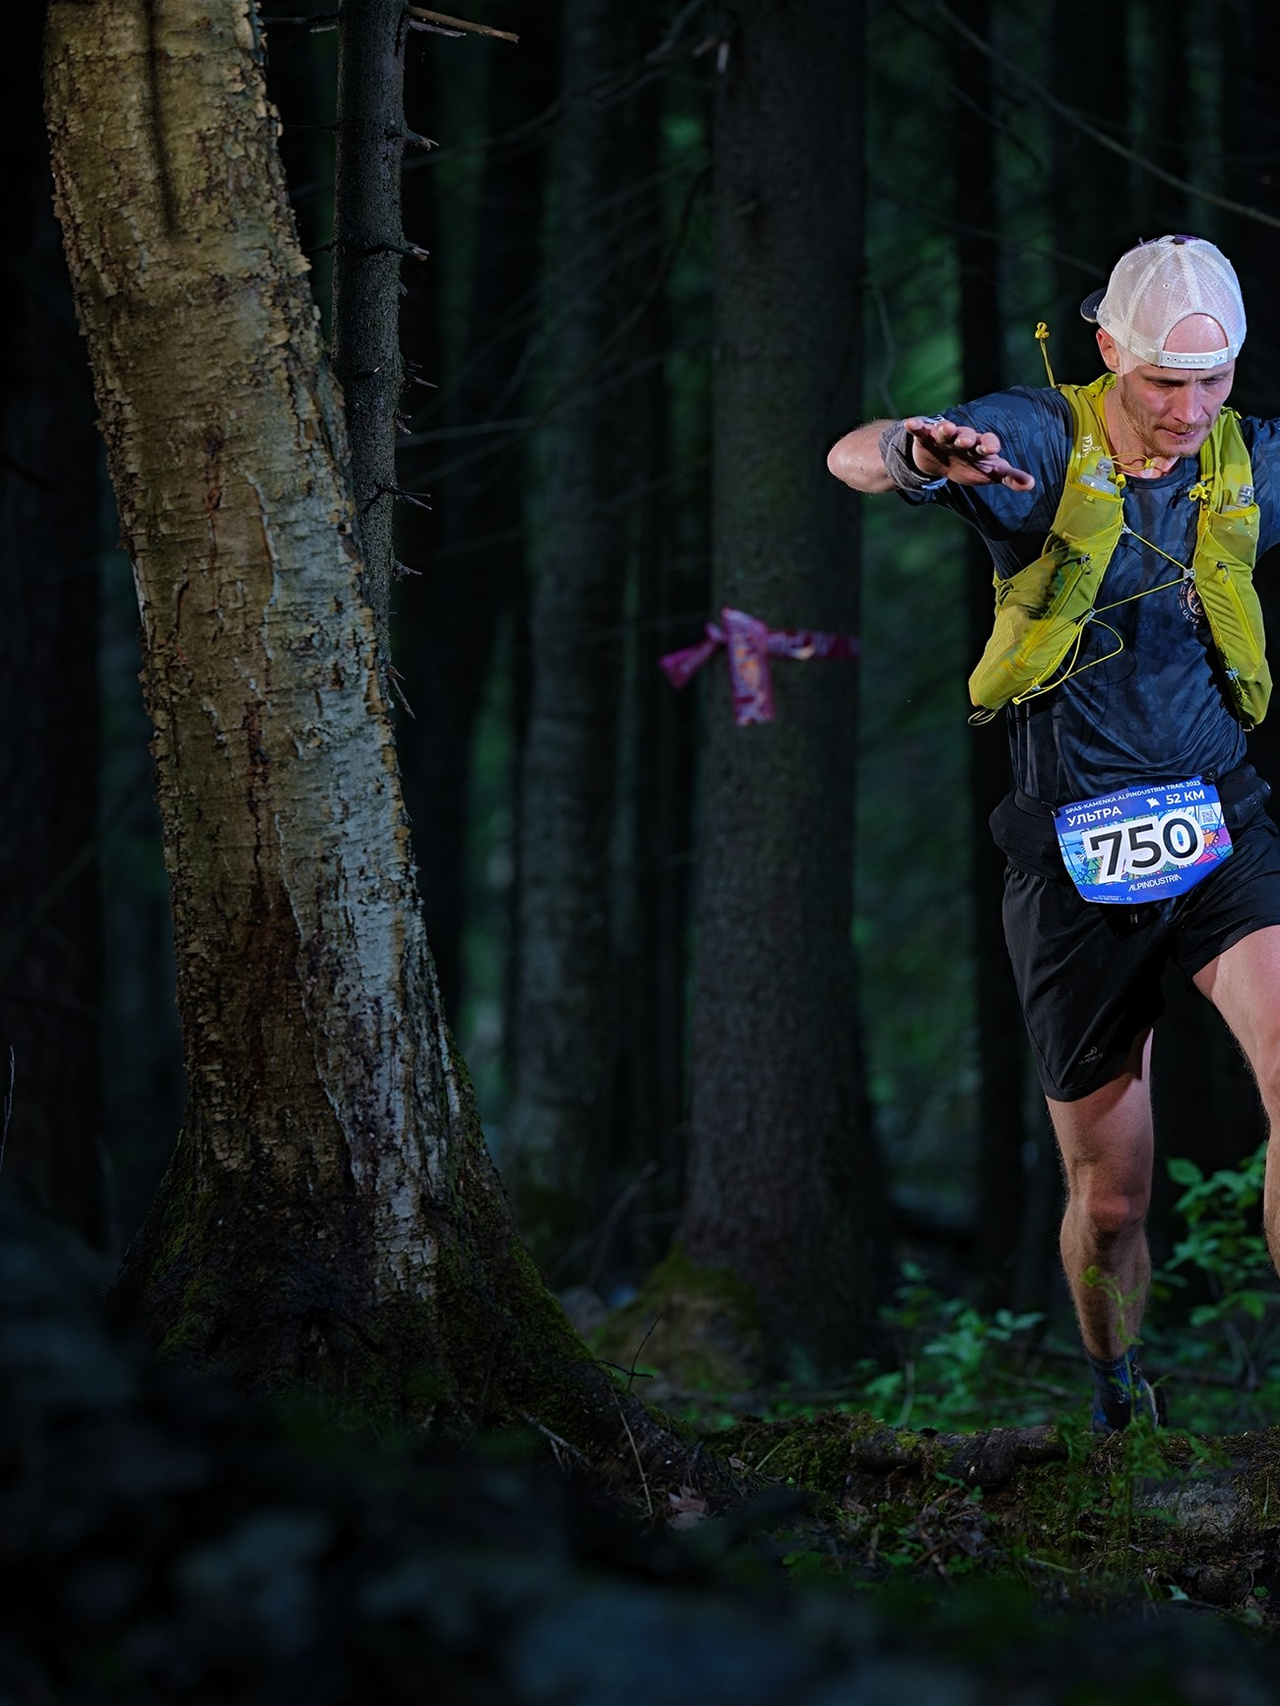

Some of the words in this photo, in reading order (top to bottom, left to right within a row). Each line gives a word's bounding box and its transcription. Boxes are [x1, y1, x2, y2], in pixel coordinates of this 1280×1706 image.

[1065, 797, 1117, 815] SPAS-KAMENKA
[1118, 786, 1166, 801] ALPINDUSTRIA
[1167, 782, 1185, 790] TRAIL
[1186, 780, 1201, 788] 2023
[1165, 793, 1182, 805] 52
[1066, 805, 1123, 827] УЛЬТРА
[1089, 817, 1199, 877] 750
[1128, 874, 1182, 892] ALPINDUSTRIA
